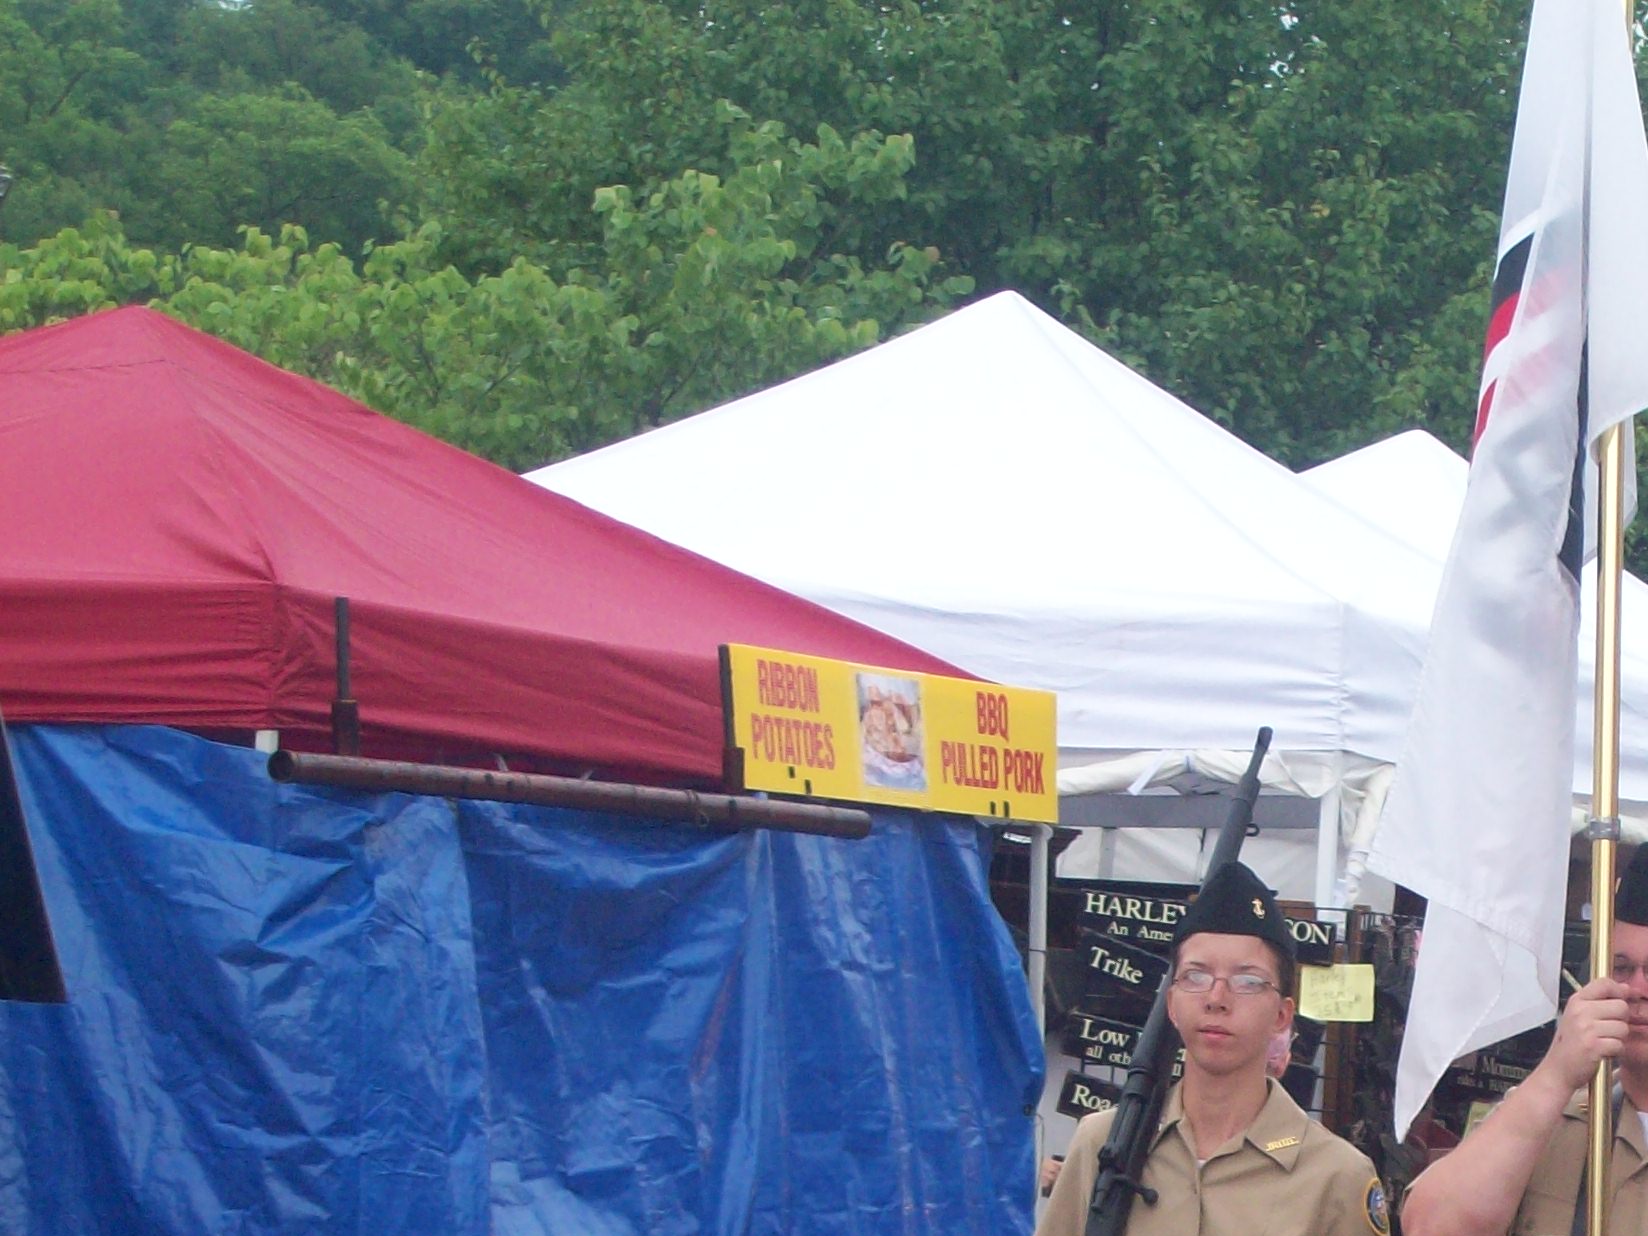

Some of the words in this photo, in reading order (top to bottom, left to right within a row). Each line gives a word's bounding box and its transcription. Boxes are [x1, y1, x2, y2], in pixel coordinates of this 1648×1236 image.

[757, 659, 820, 713] RIBBON
[751, 712, 836, 770] POTATOES
[975, 690, 1010, 742] BBQ
[940, 740, 998, 789] PULLED
[1003, 750, 1046, 795] PORK
[1107, 920, 1129, 936] An
[1090, 946, 1144, 984] Trike
[1080, 1018, 1131, 1048] Low
